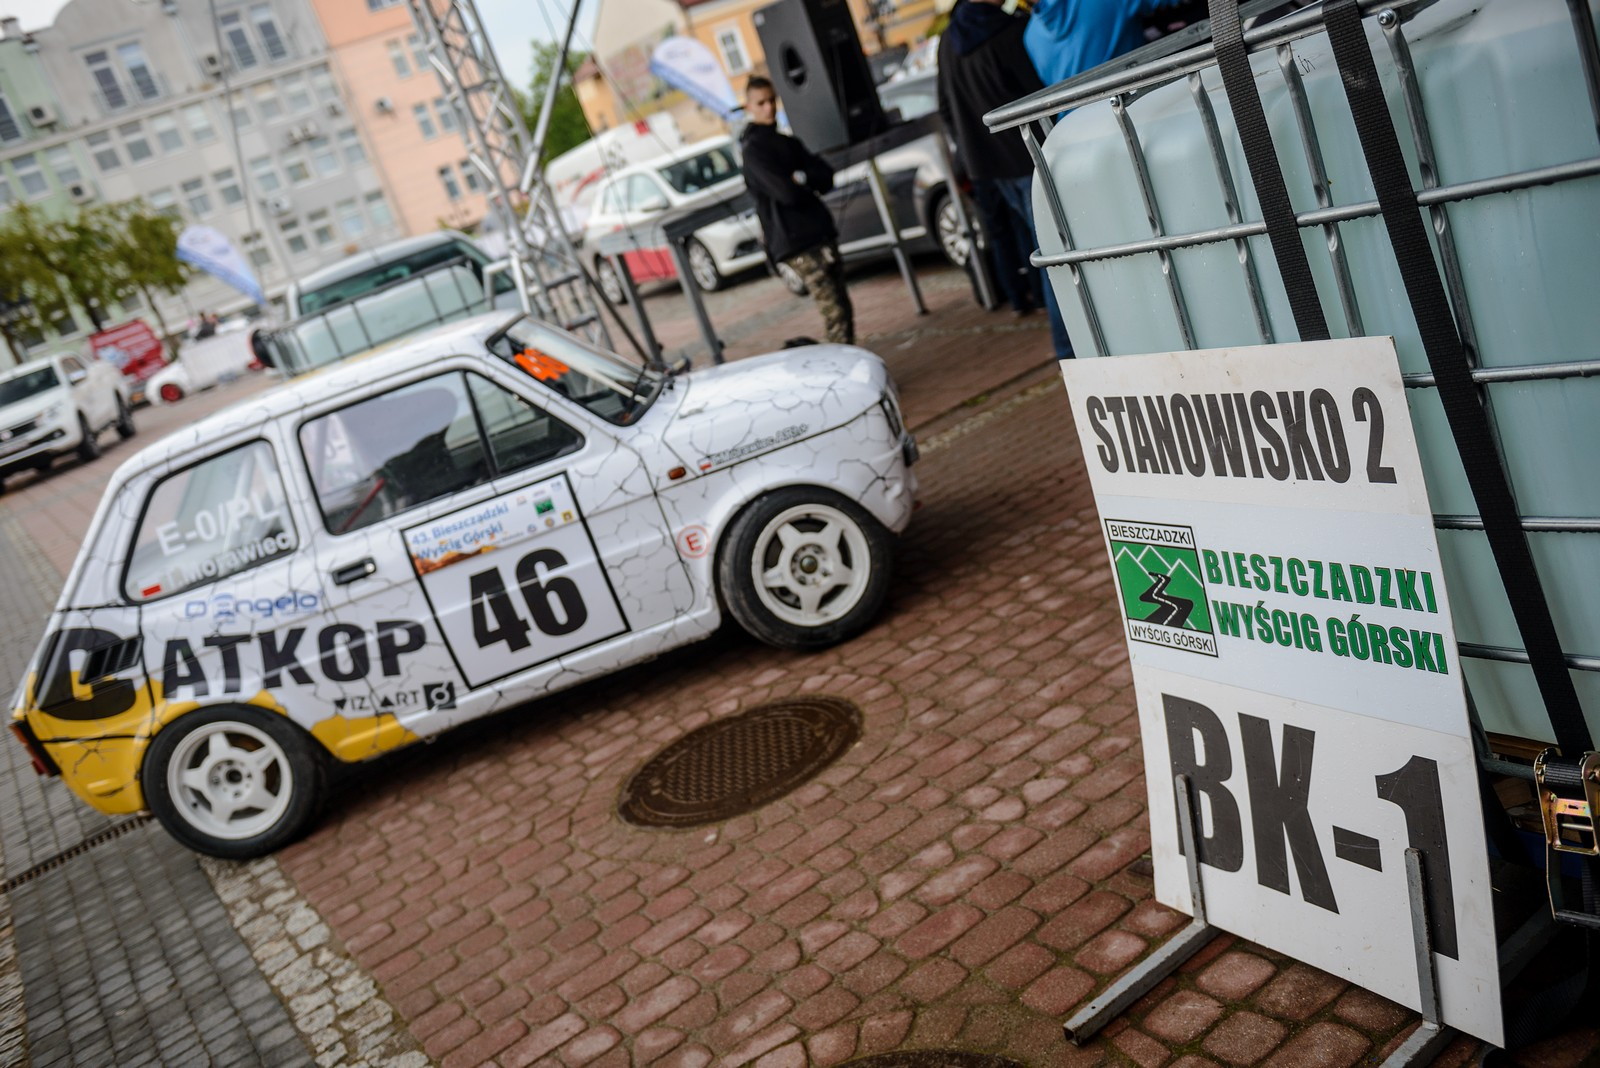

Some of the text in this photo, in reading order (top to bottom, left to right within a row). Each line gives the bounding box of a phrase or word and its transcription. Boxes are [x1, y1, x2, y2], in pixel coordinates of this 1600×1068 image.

[1086, 386, 1397, 484] STANOWISKO 2
[432, 502, 509, 539] Bieszczadzki
[462, 521, 505, 545] Górski
[686, 533, 702, 551] E
[1110, 524, 1192, 545] BIESZCZADZKI
[469, 548, 588, 652] 46
[1201, 548, 1438, 614] BIESZCZADZKI
[1131, 624, 1214, 652] WYŚCIG GÓRSKI
[1211, 600, 1449, 675] WYŚCIG GÓRSKI
[1161, 692, 1459, 961] BK-1
